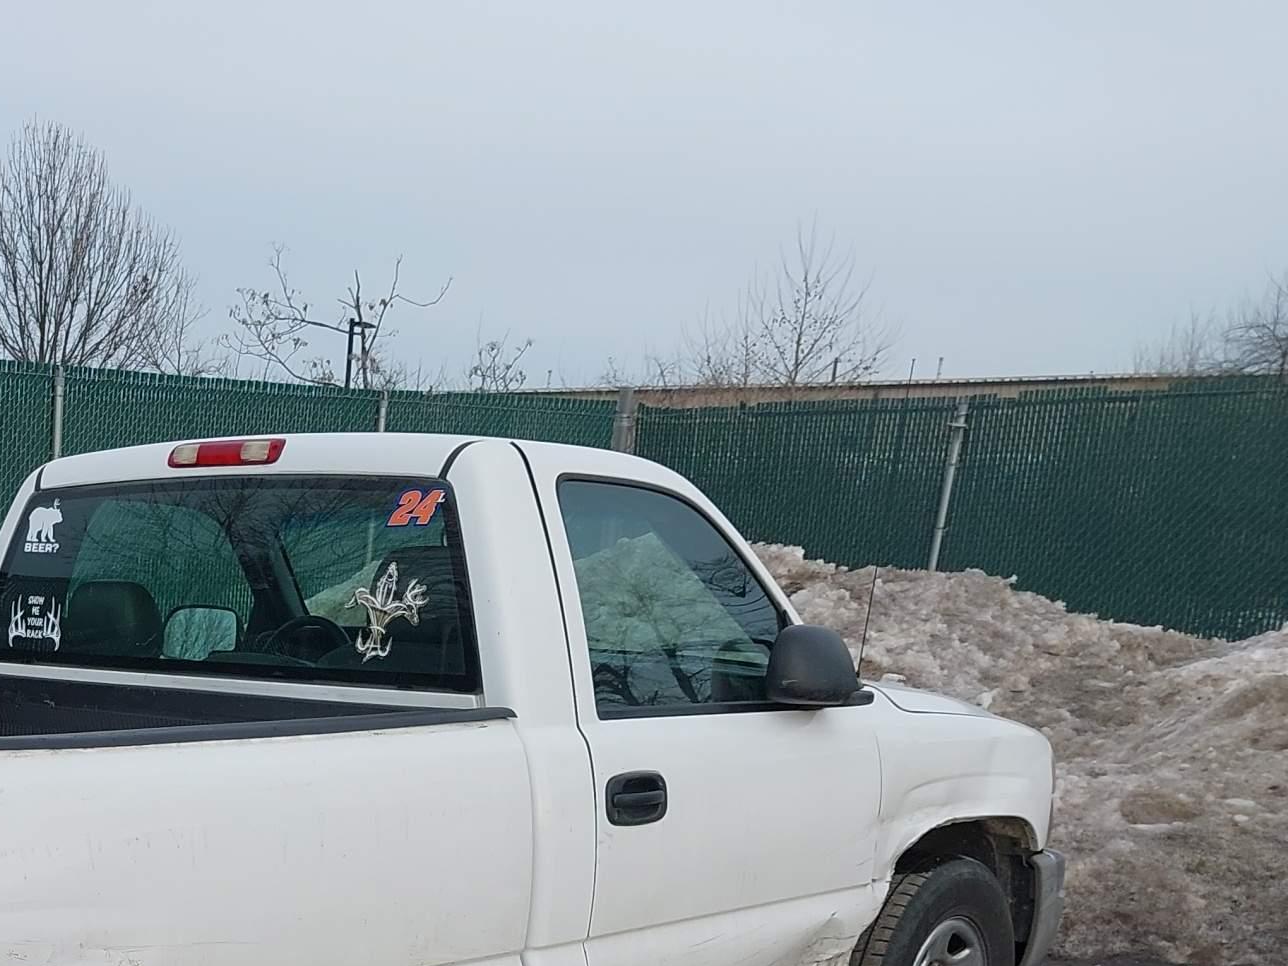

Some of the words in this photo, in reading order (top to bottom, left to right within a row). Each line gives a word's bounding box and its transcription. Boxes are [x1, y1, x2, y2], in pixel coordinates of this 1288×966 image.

[385, 489, 444, 527] 24
[24, 542, 60, 553] BEER?
[28, 595, 45, 605] SHOW
[31, 606, 41, 616] ME
[27, 617, 44, 627] YOUR
[26, 629, 44, 639] RACK
